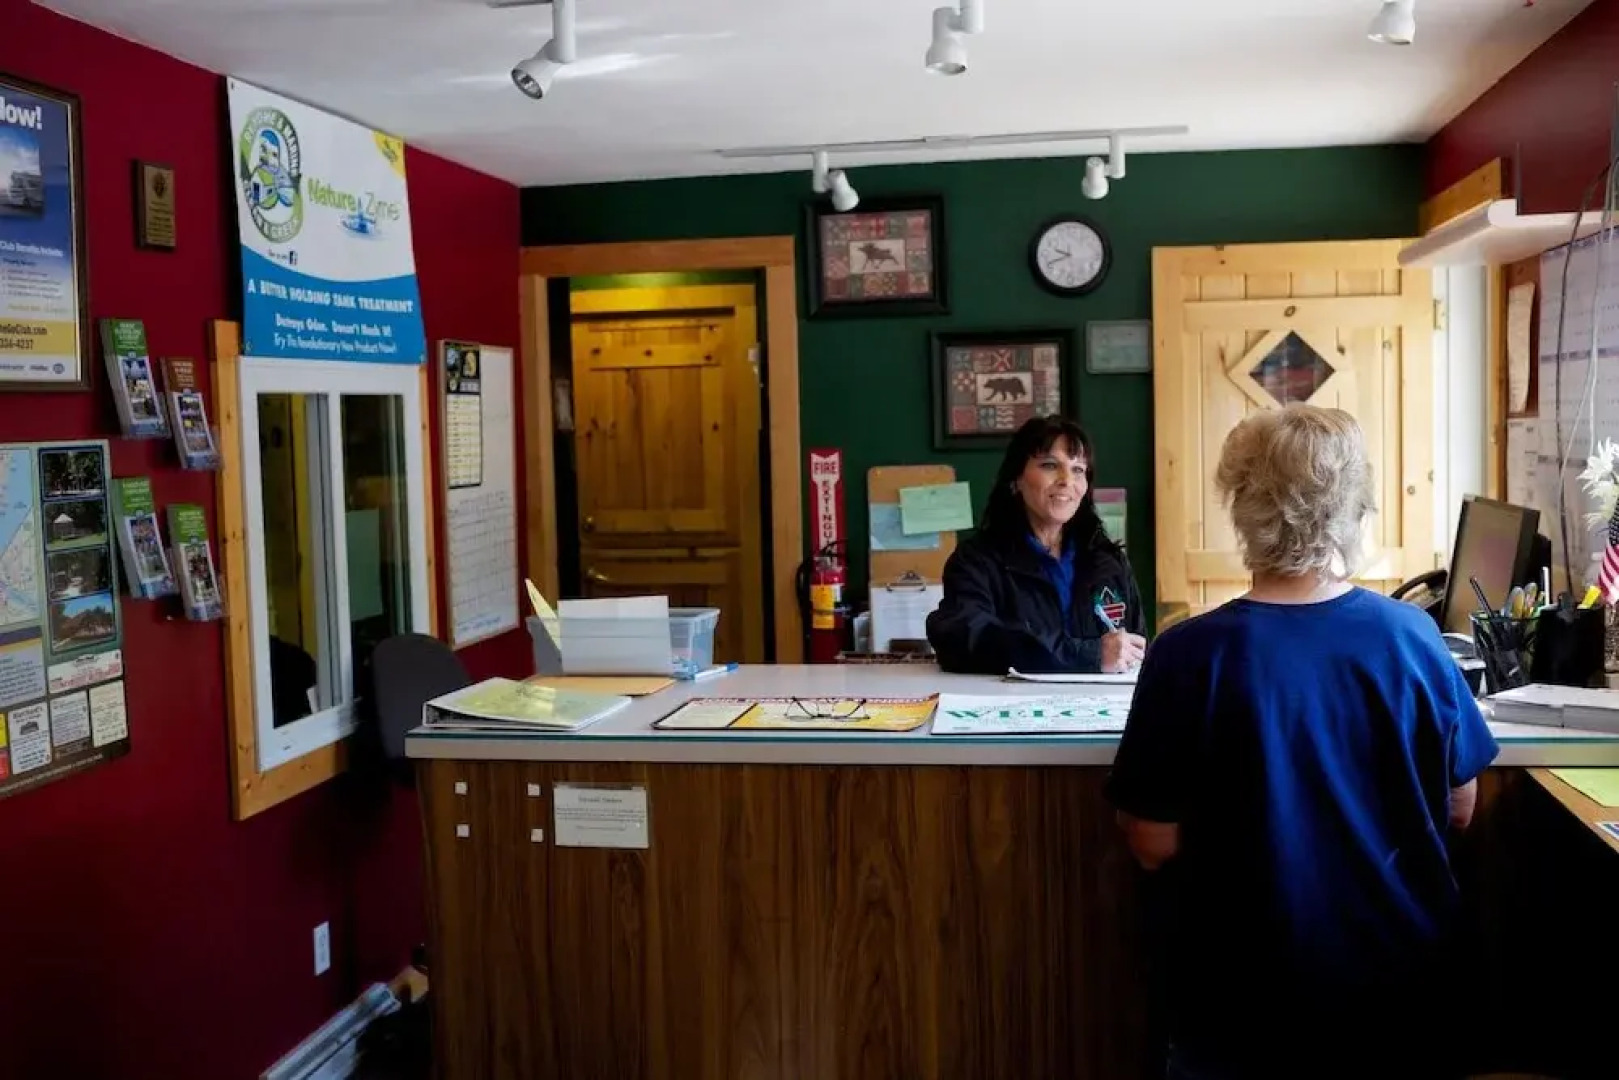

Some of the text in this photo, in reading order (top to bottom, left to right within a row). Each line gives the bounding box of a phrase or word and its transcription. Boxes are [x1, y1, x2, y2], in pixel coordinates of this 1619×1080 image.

[308, 178, 357, 212] Nature
[248, 278, 256, 294] A
[290, 287, 331, 306] HOLDING
[332, 293, 357, 309] TANK
[358, 297, 414, 313] TREATMENT
[814, 462, 836, 475] FIRE
